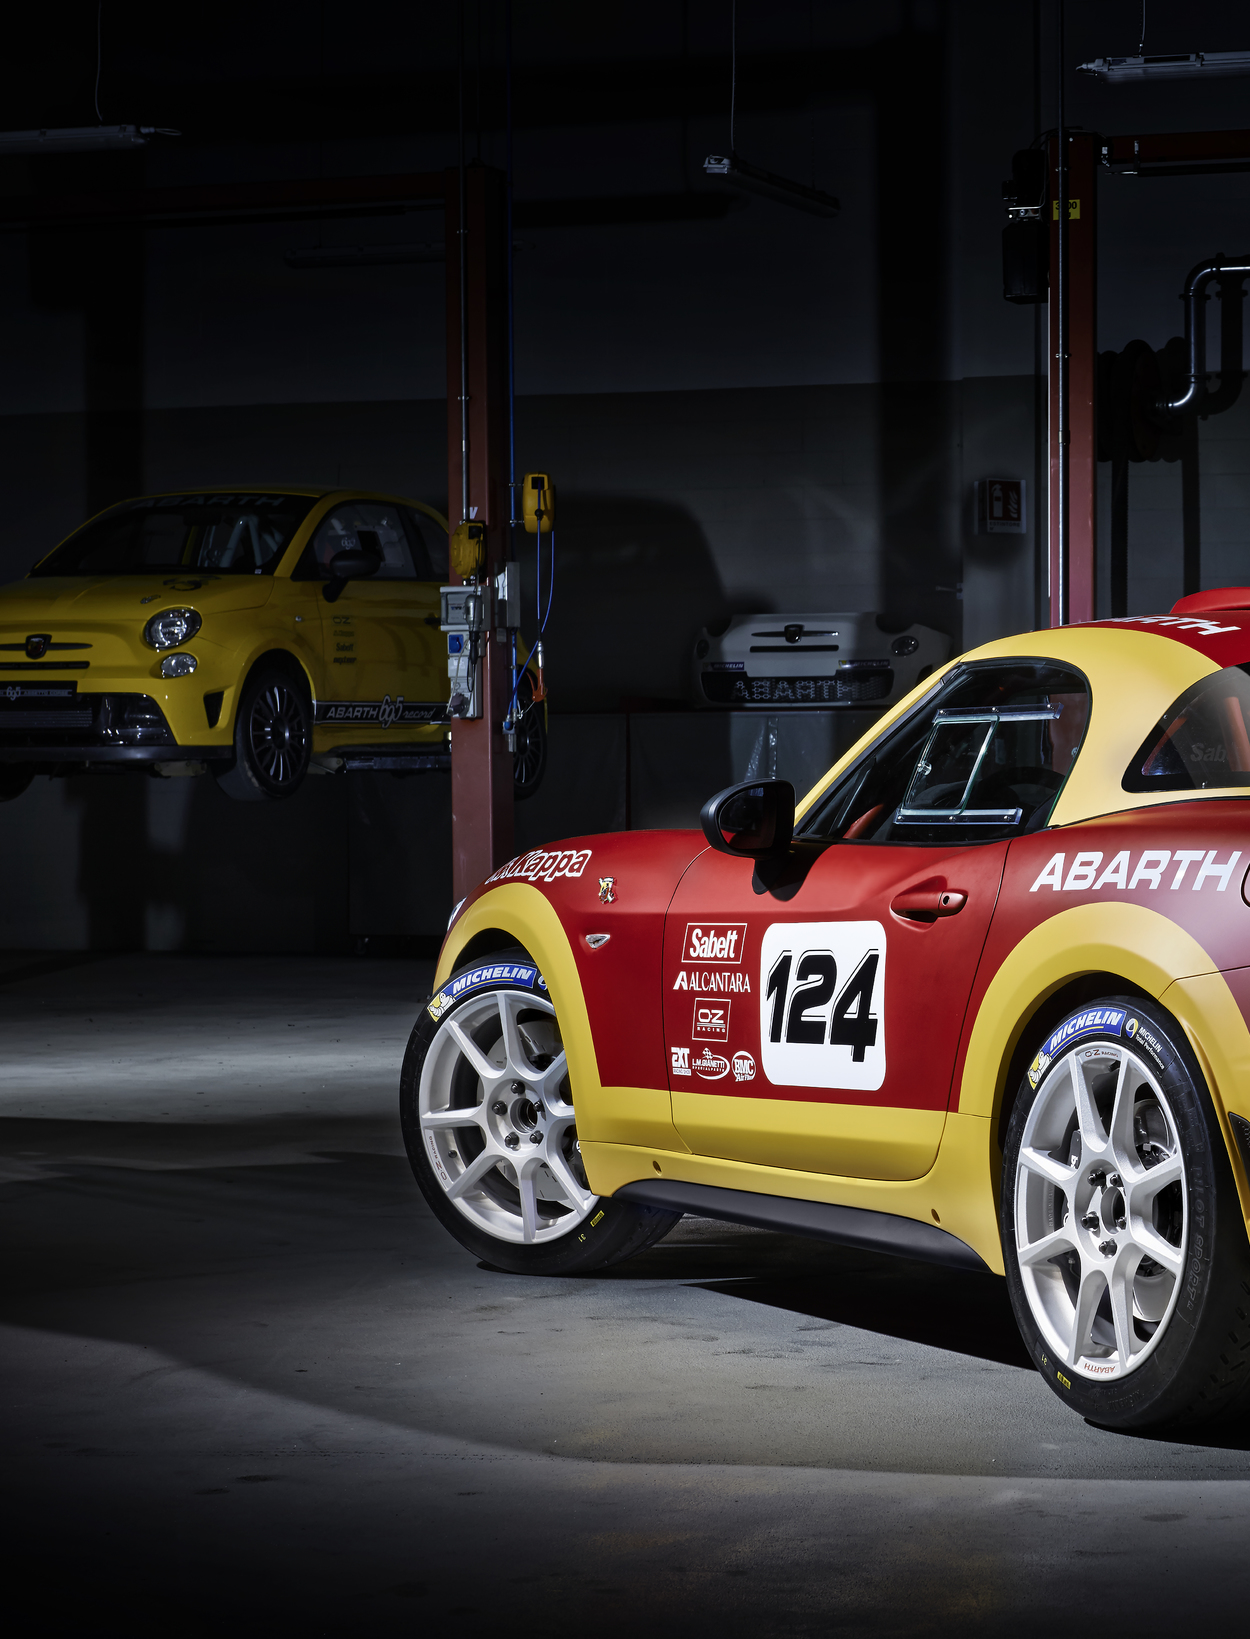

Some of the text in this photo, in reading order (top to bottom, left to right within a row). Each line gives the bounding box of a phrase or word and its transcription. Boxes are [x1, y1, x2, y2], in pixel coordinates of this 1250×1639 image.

[326, 694, 436, 729] ABARTH 695 record
[505, 849, 592, 882] Kappa
[1029, 850, 1242, 892] ABARTH
[690, 928, 738, 958] Sabelt
[452, 966, 534, 995] MICHELIN
[698, 1008, 725, 1024] OZ
[766, 949, 879, 1063] 124
[1050, 1010, 1122, 1051] MICHELIN
[734, 1059, 754, 1075] BMC
[1084, 1363, 1116, 1374] ABARTH
